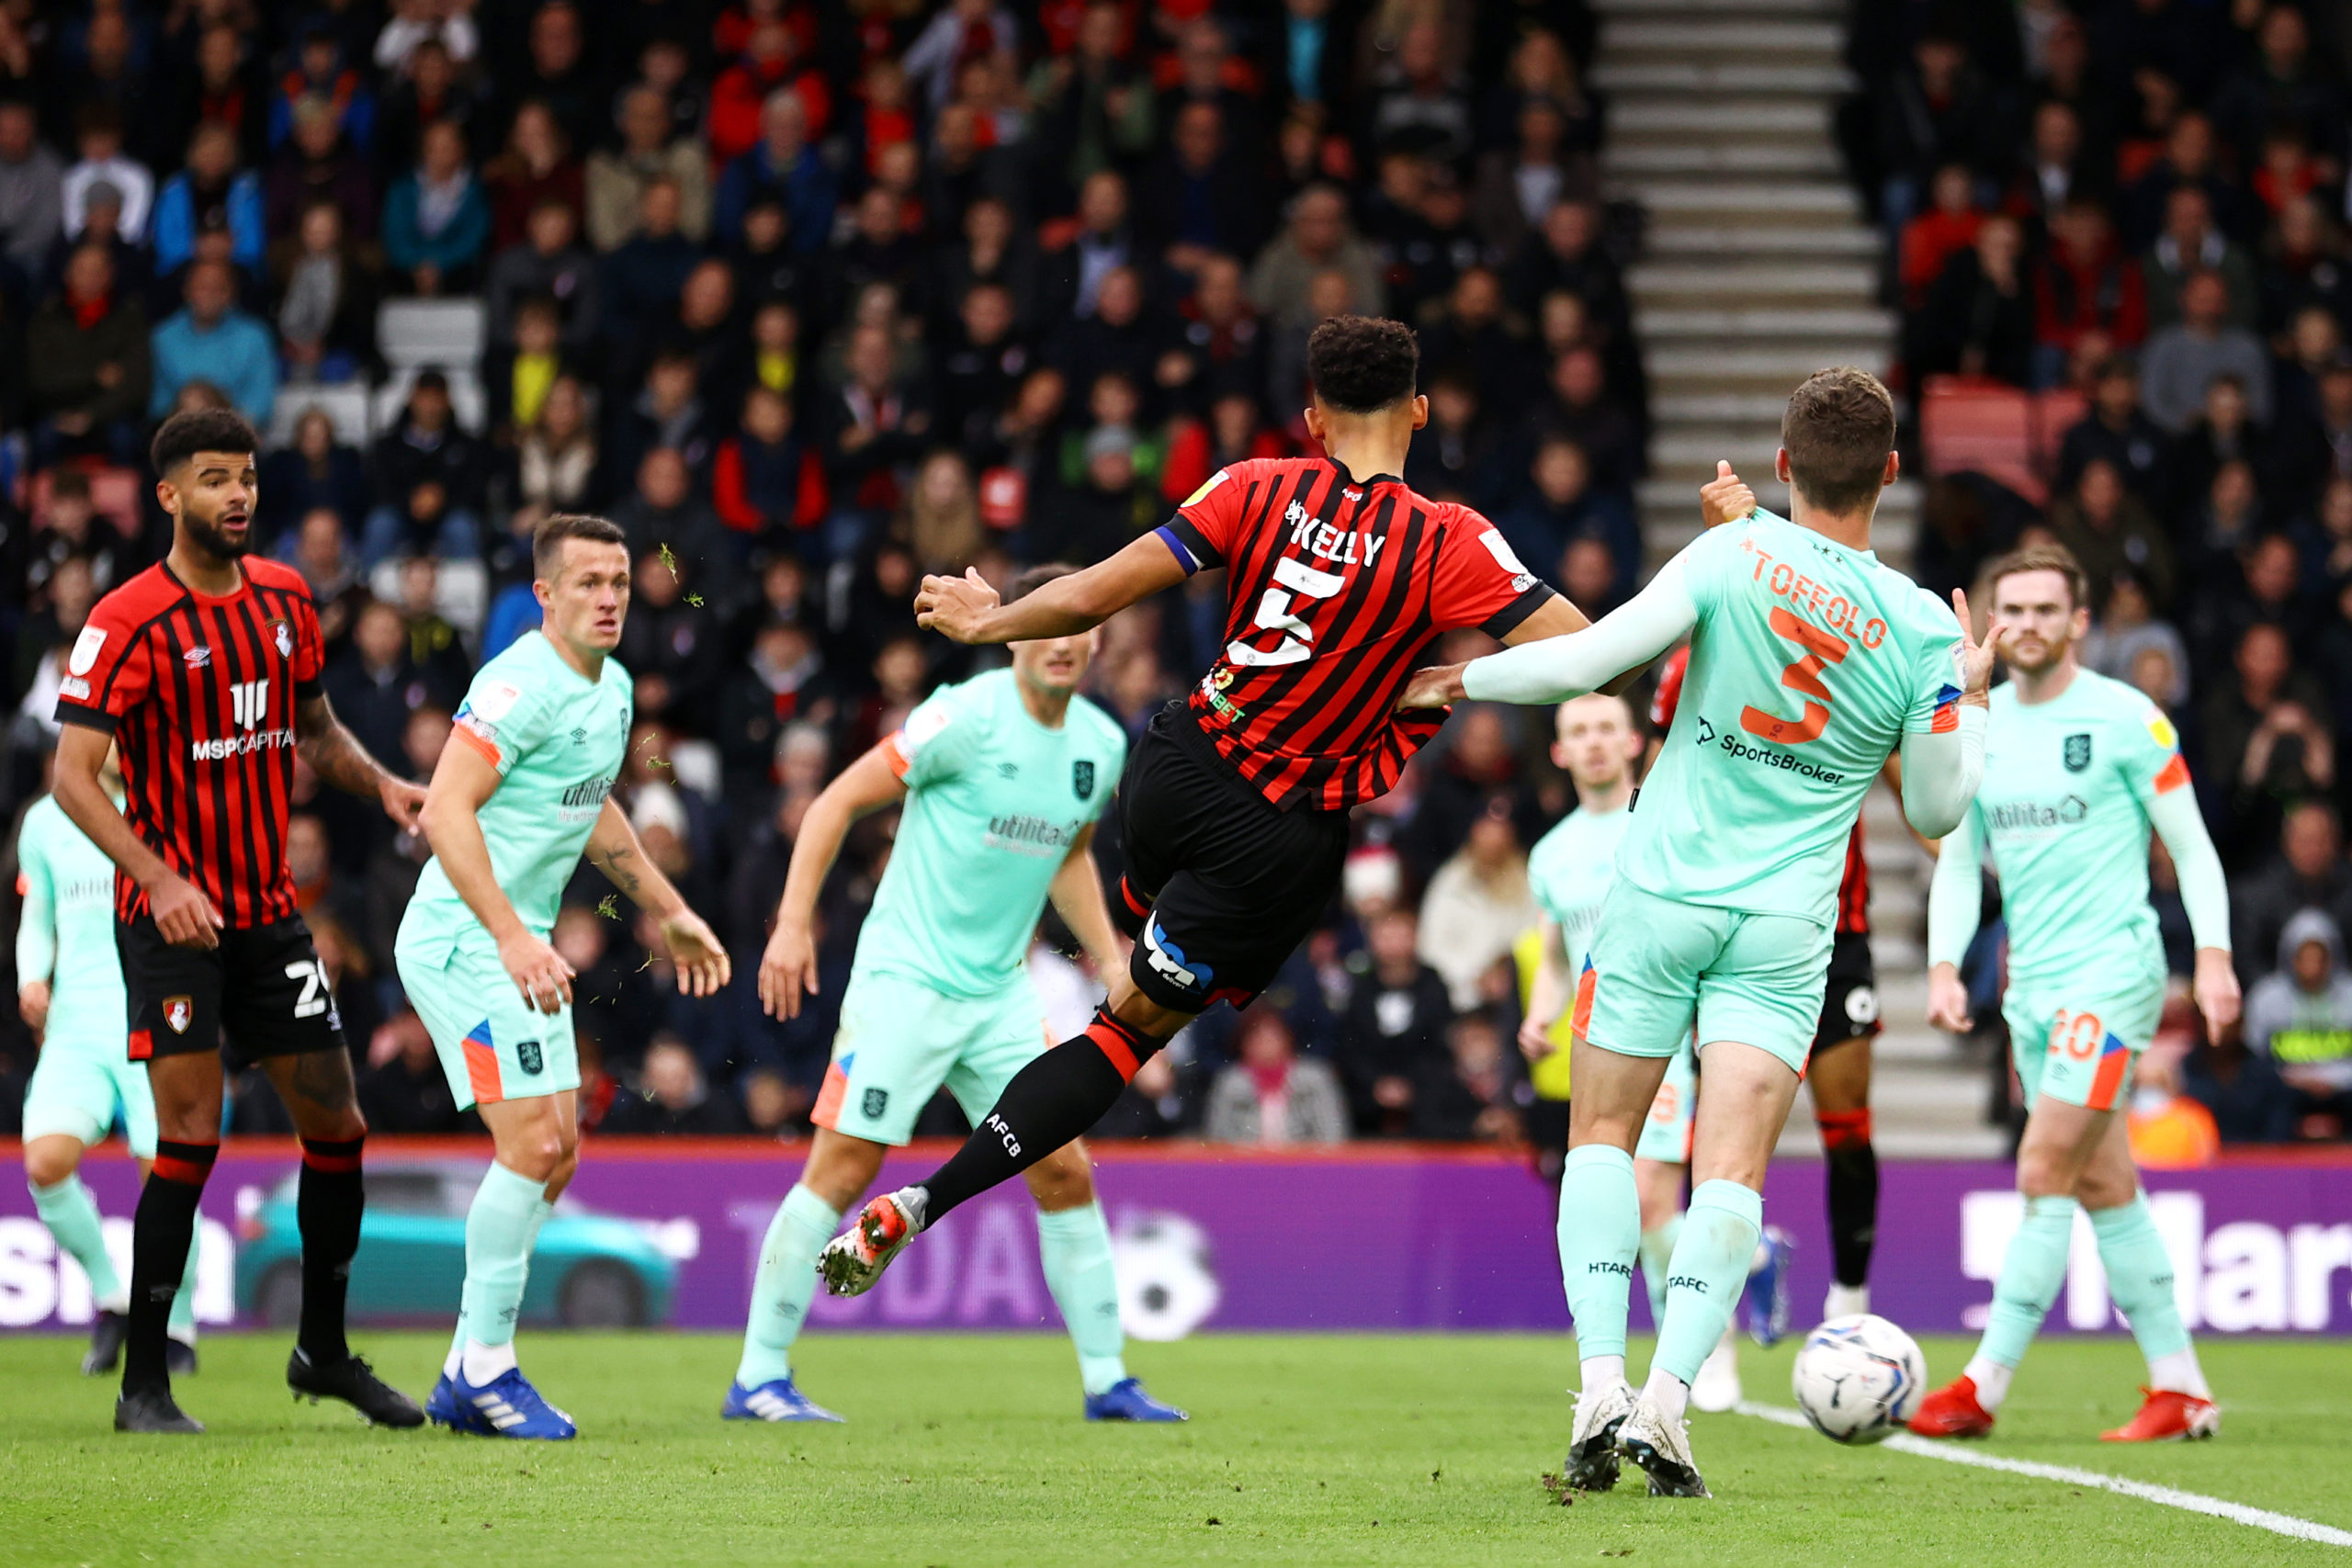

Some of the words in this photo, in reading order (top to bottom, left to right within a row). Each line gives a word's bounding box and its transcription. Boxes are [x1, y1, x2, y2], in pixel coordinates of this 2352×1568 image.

[1290, 513, 1386, 568] KELLY
[1226, 556, 1346, 667] 5
[1753, 548, 1887, 649] TOFFOLO
[1739, 605, 1849, 745] 3
[192, 727, 296, 761] MSPCAPITA
[1720, 734, 1845, 785] SportsBroker
[284, 956, 337, 1020] 2
[986, 1112, 1022, 1157] AFCB
[1666, 1275, 1709, 1294] TAFC
